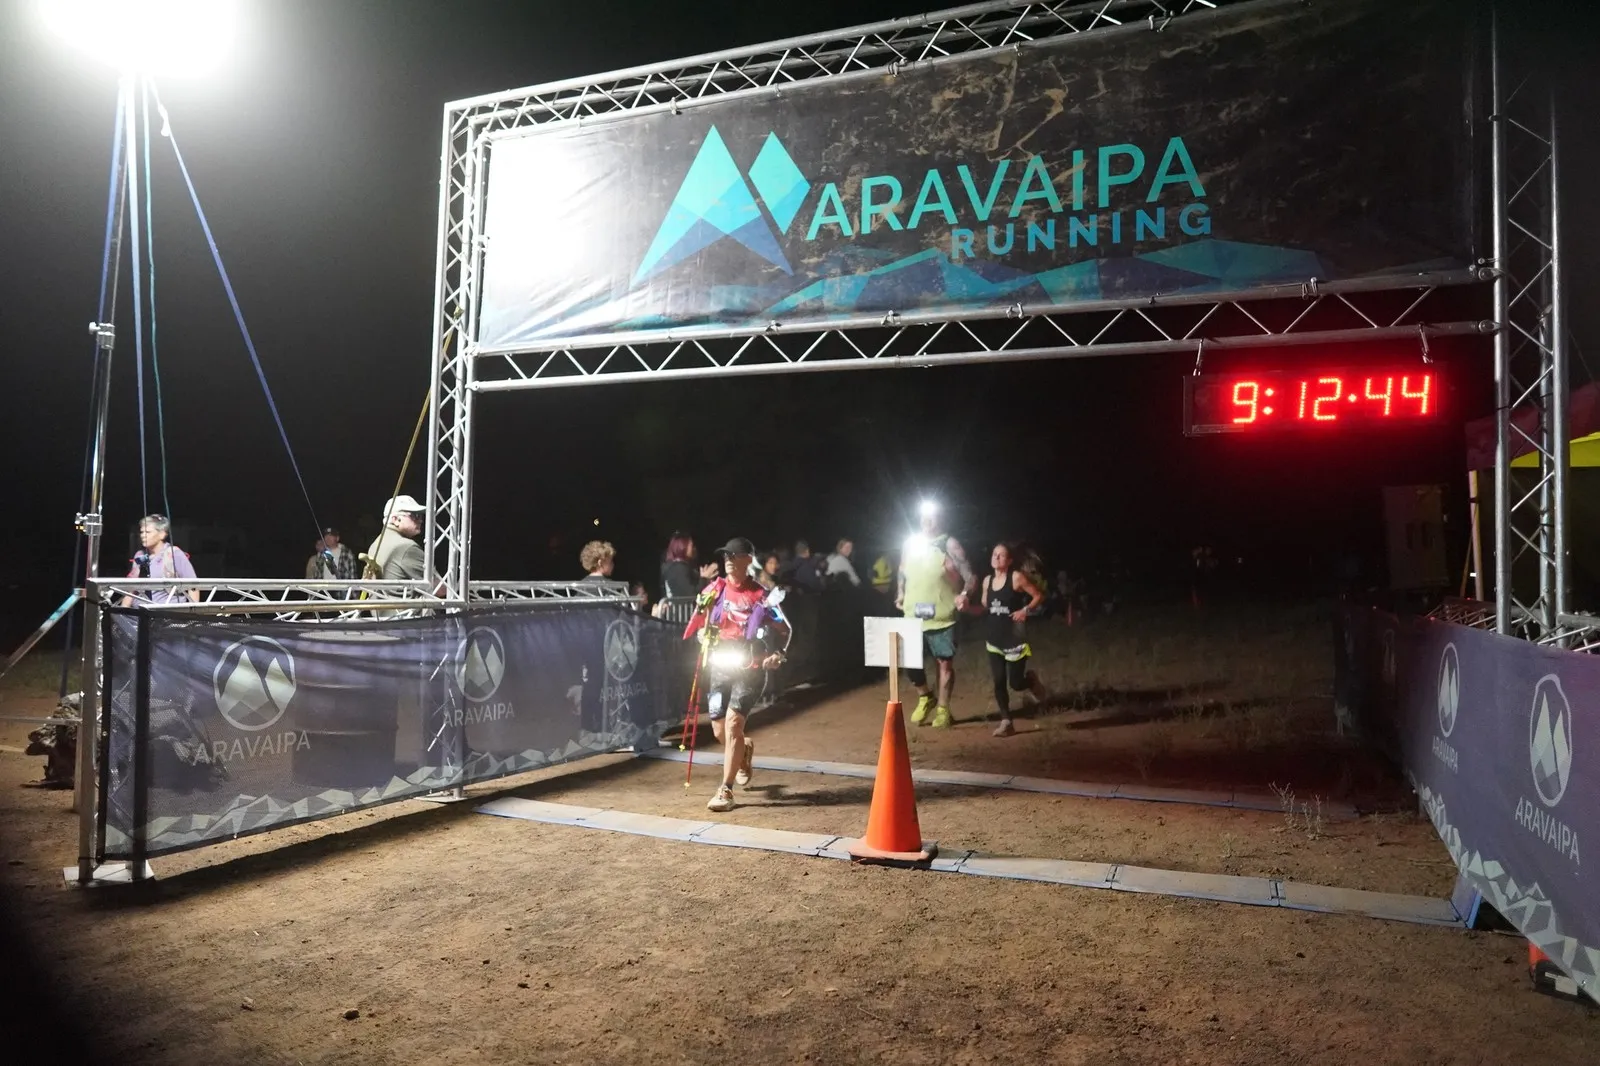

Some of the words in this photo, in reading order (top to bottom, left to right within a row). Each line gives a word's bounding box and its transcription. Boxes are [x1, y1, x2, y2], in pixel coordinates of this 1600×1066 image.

[806, 136, 1207, 240] ARAVAIPA
[951, 203, 1211, 259] RUNNING
[443, 702, 515, 728] ARAVAIPA
[192, 730, 311, 766] ARAVAIPA
[1515, 796, 1580, 866] ARAVAIPA
